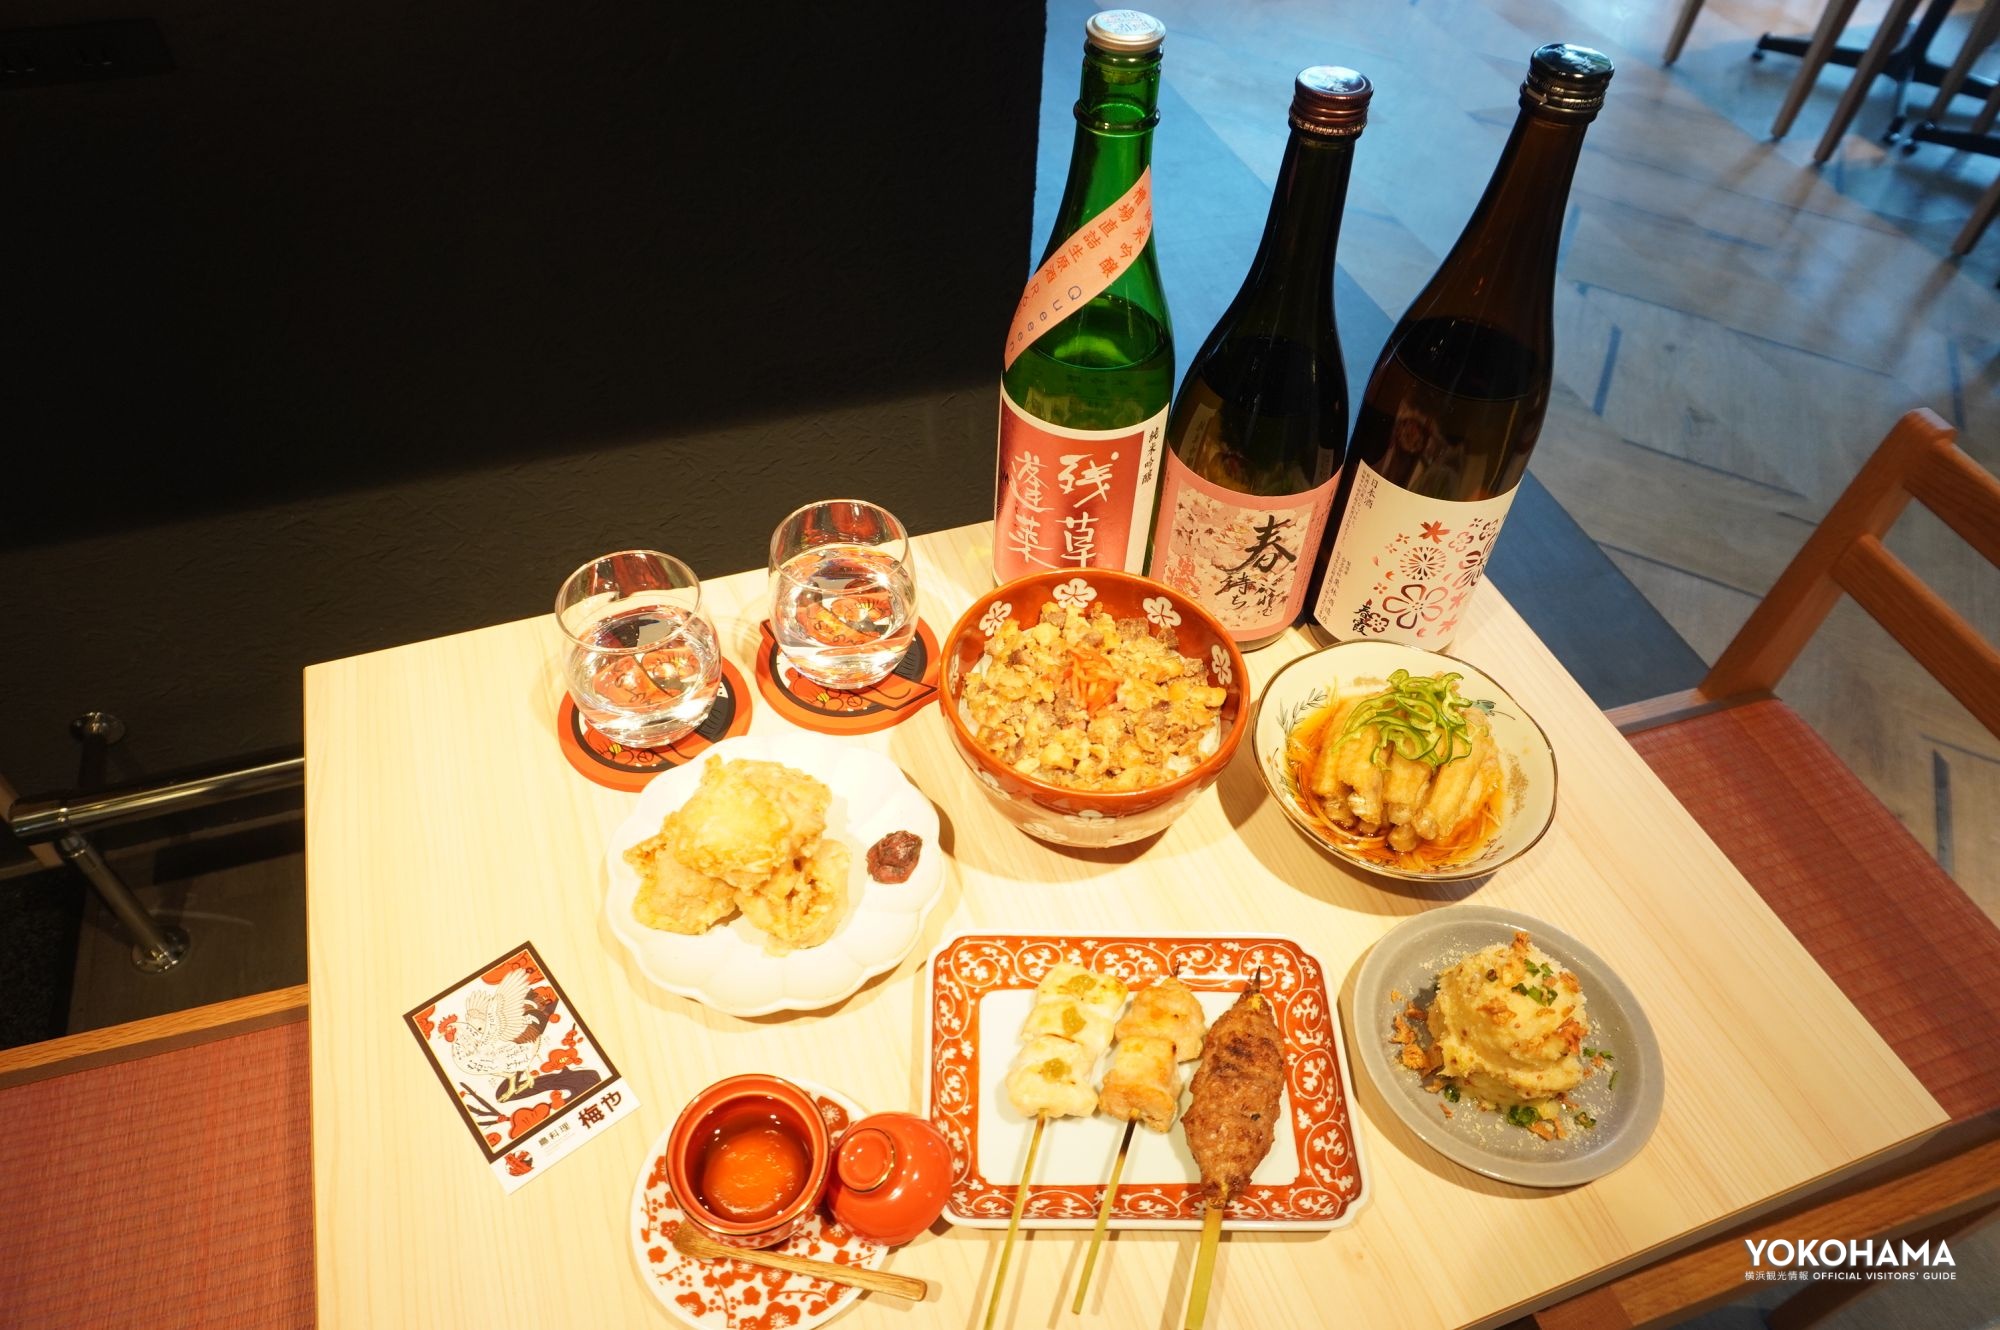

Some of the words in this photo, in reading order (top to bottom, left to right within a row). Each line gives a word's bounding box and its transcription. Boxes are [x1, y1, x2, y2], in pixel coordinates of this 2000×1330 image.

[1141, 426, 1159, 485] 純米吟醸
[1363, 478, 1379, 509] 日本酒
[578, 1089, 622, 1130] 梅や
